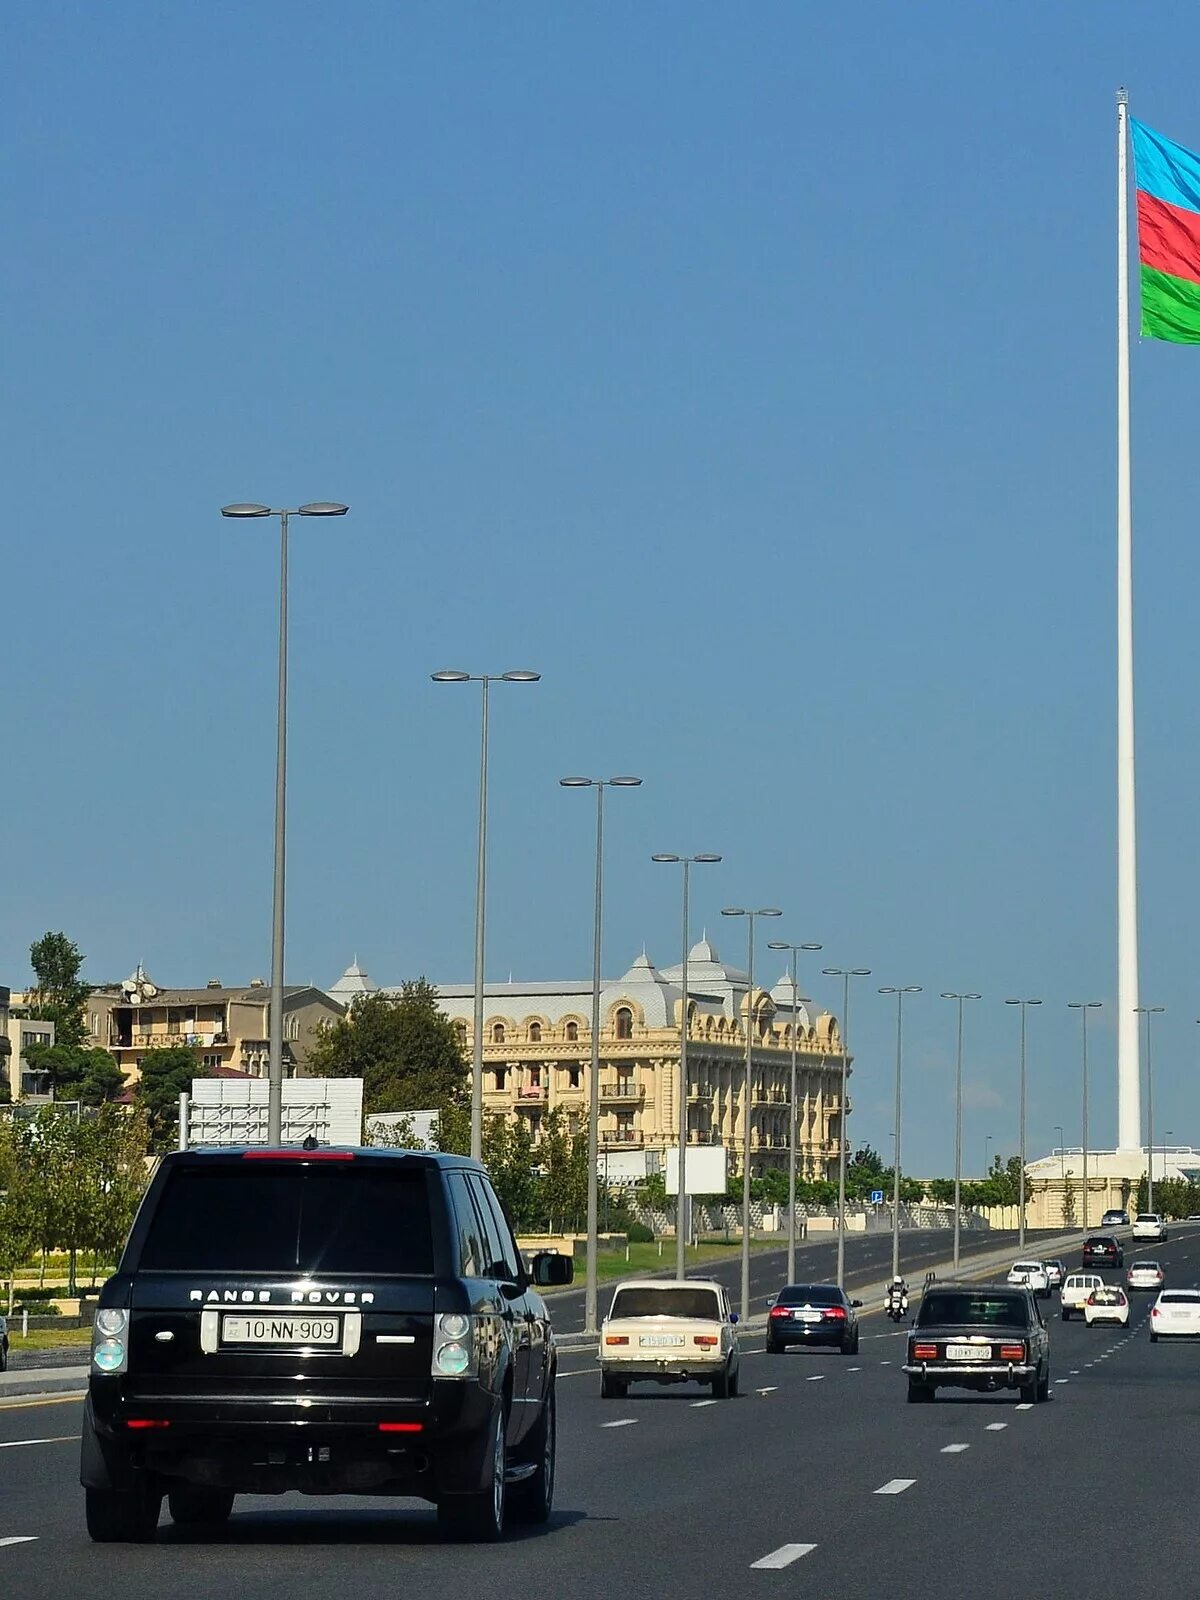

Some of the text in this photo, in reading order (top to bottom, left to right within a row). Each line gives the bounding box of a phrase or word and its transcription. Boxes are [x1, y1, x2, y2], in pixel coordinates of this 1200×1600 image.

[190, 1290, 374, 1304] RANGE ROVER
[245, 1321, 335, 1339] 10-NN-909
